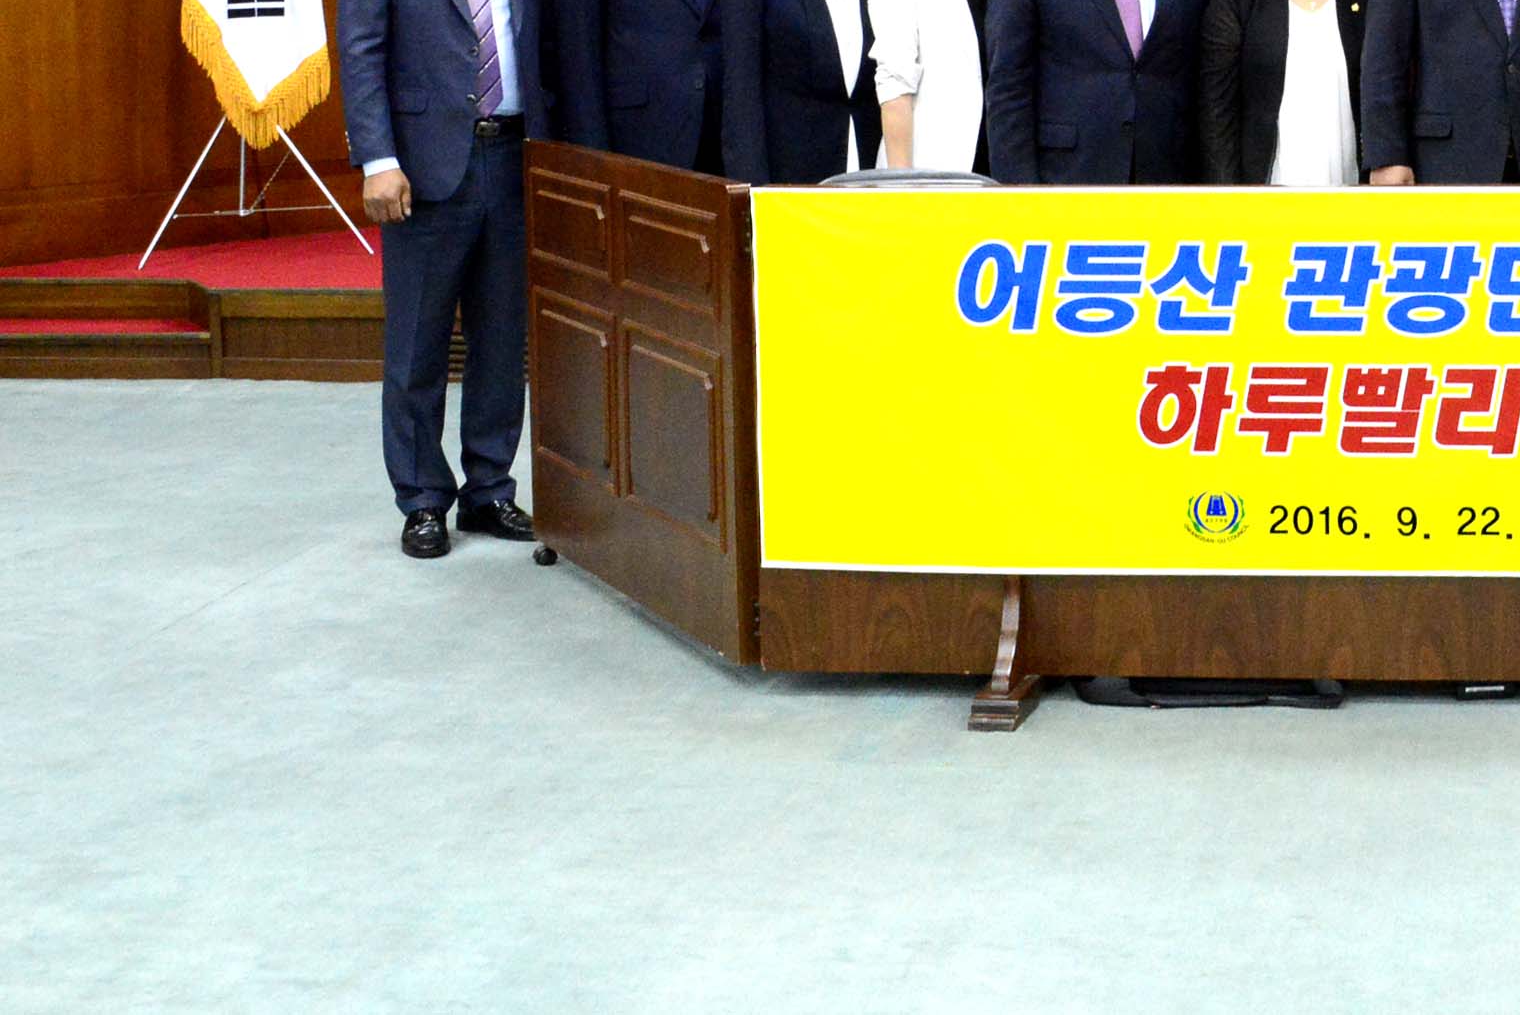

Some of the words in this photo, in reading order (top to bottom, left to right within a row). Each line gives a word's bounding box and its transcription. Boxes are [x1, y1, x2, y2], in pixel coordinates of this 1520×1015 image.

[957, 242, 1247, 332] 어등산
[1269, 505, 1370, 538] 2016.
[1397, 506, 1429, 539] 9.
[1457, 506, 1512, 539] 22.
